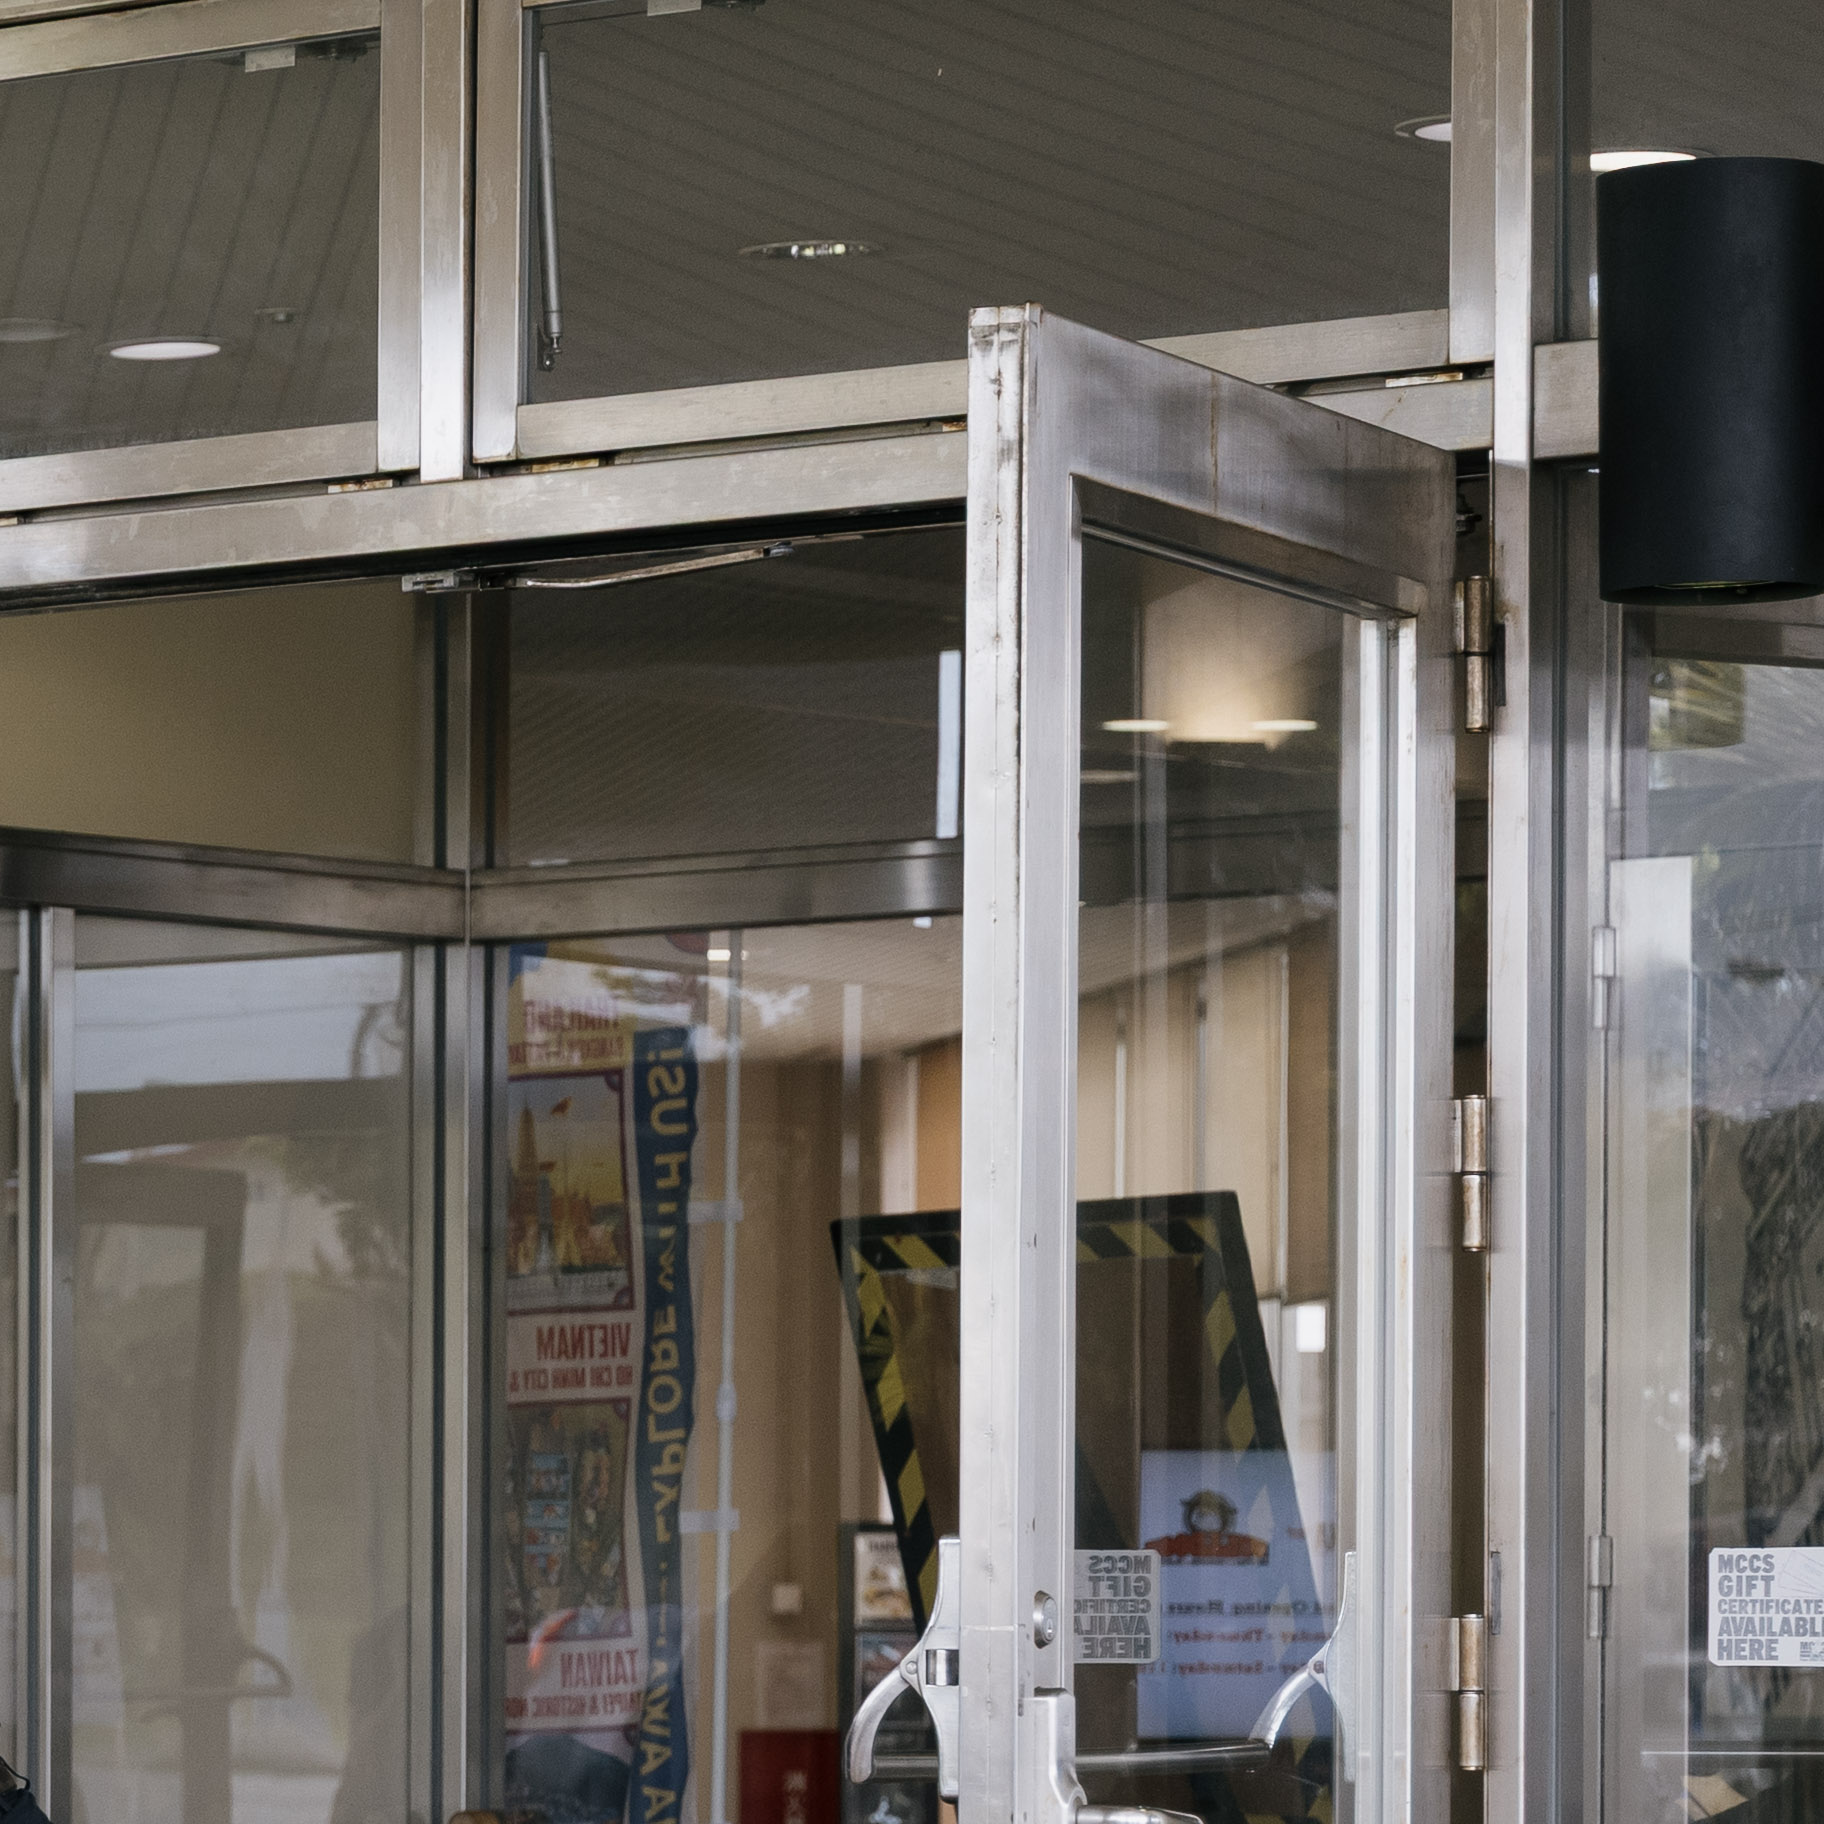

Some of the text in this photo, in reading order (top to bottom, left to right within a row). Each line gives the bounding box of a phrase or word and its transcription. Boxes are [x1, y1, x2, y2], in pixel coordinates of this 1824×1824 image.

[1717, 1554, 1775, 1574] MCCS
[1718, 1575, 1775, 1597] GIFT
[1718, 1616, 1824, 1637] AVAILABL
[1717, 1638, 1779, 1661] HERE
